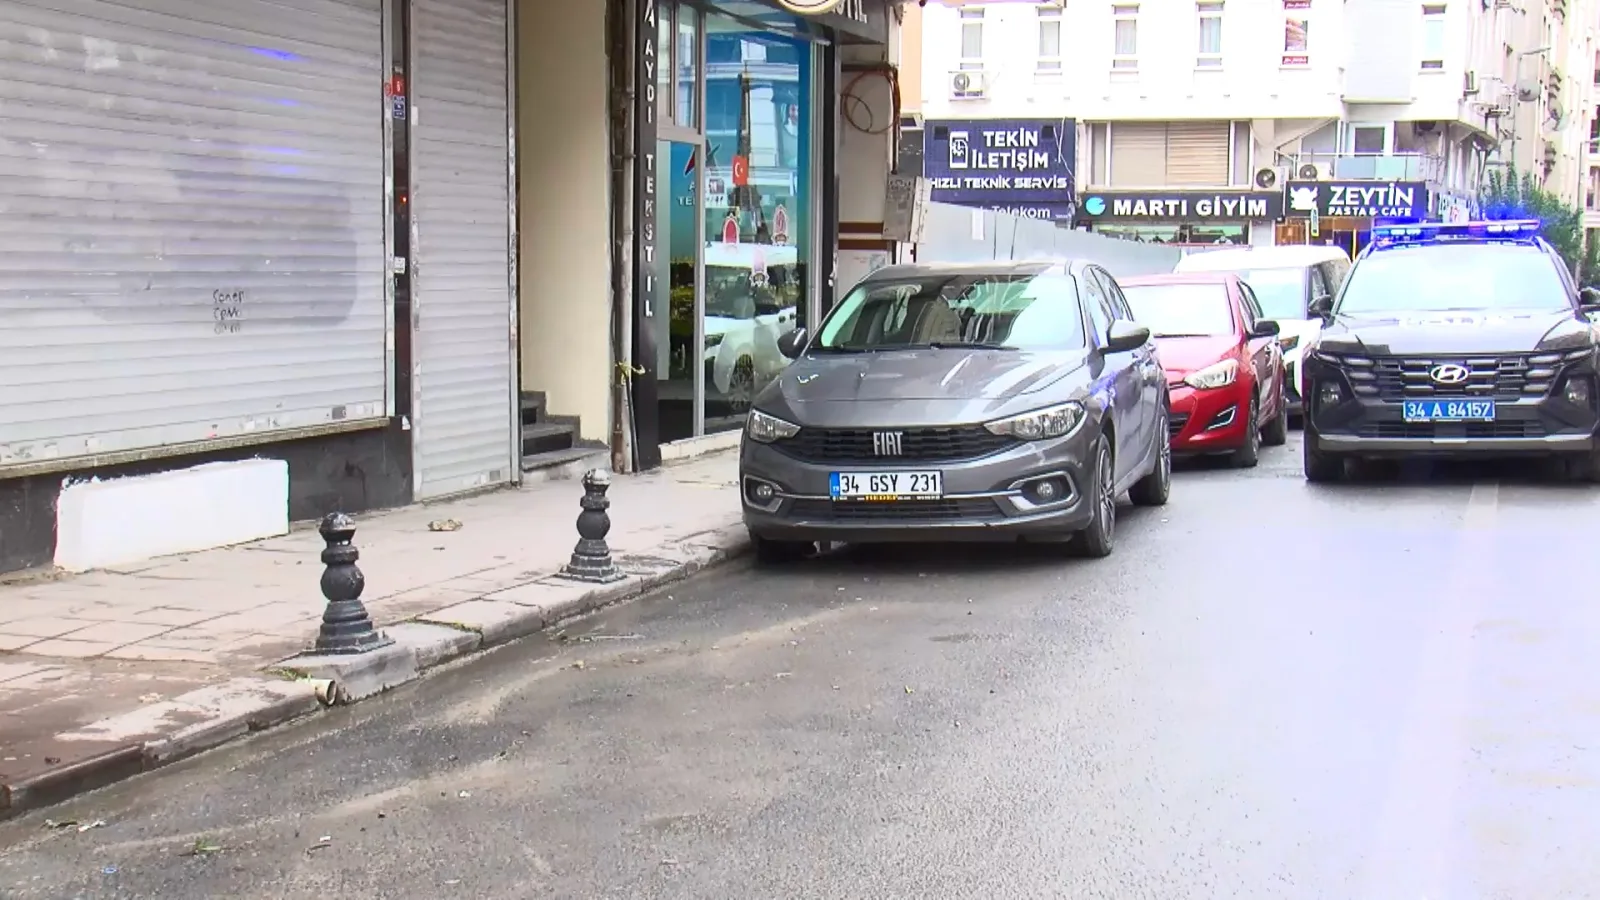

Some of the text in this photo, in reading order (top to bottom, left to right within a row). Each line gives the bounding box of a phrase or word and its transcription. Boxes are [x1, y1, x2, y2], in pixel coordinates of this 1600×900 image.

[983, 127, 1038, 147] TEKİN
[972, 149, 1048, 171] İLETİŞİM
[931, 175, 1067, 189] HIZLI TEKNİK SERVİS
[1328, 183, 1414, 207] ZEYTİN
[1113, 196, 1267, 217] MARTI GİYİM
[1328, 207, 1367, 216] PASTA
[1380, 207, 1413, 217] CAFE
[1407, 402, 1491, 418] 34 A 84157
[872, 431, 904, 456] FIAT
[841, 474, 938, 493] 34 GSY 231
